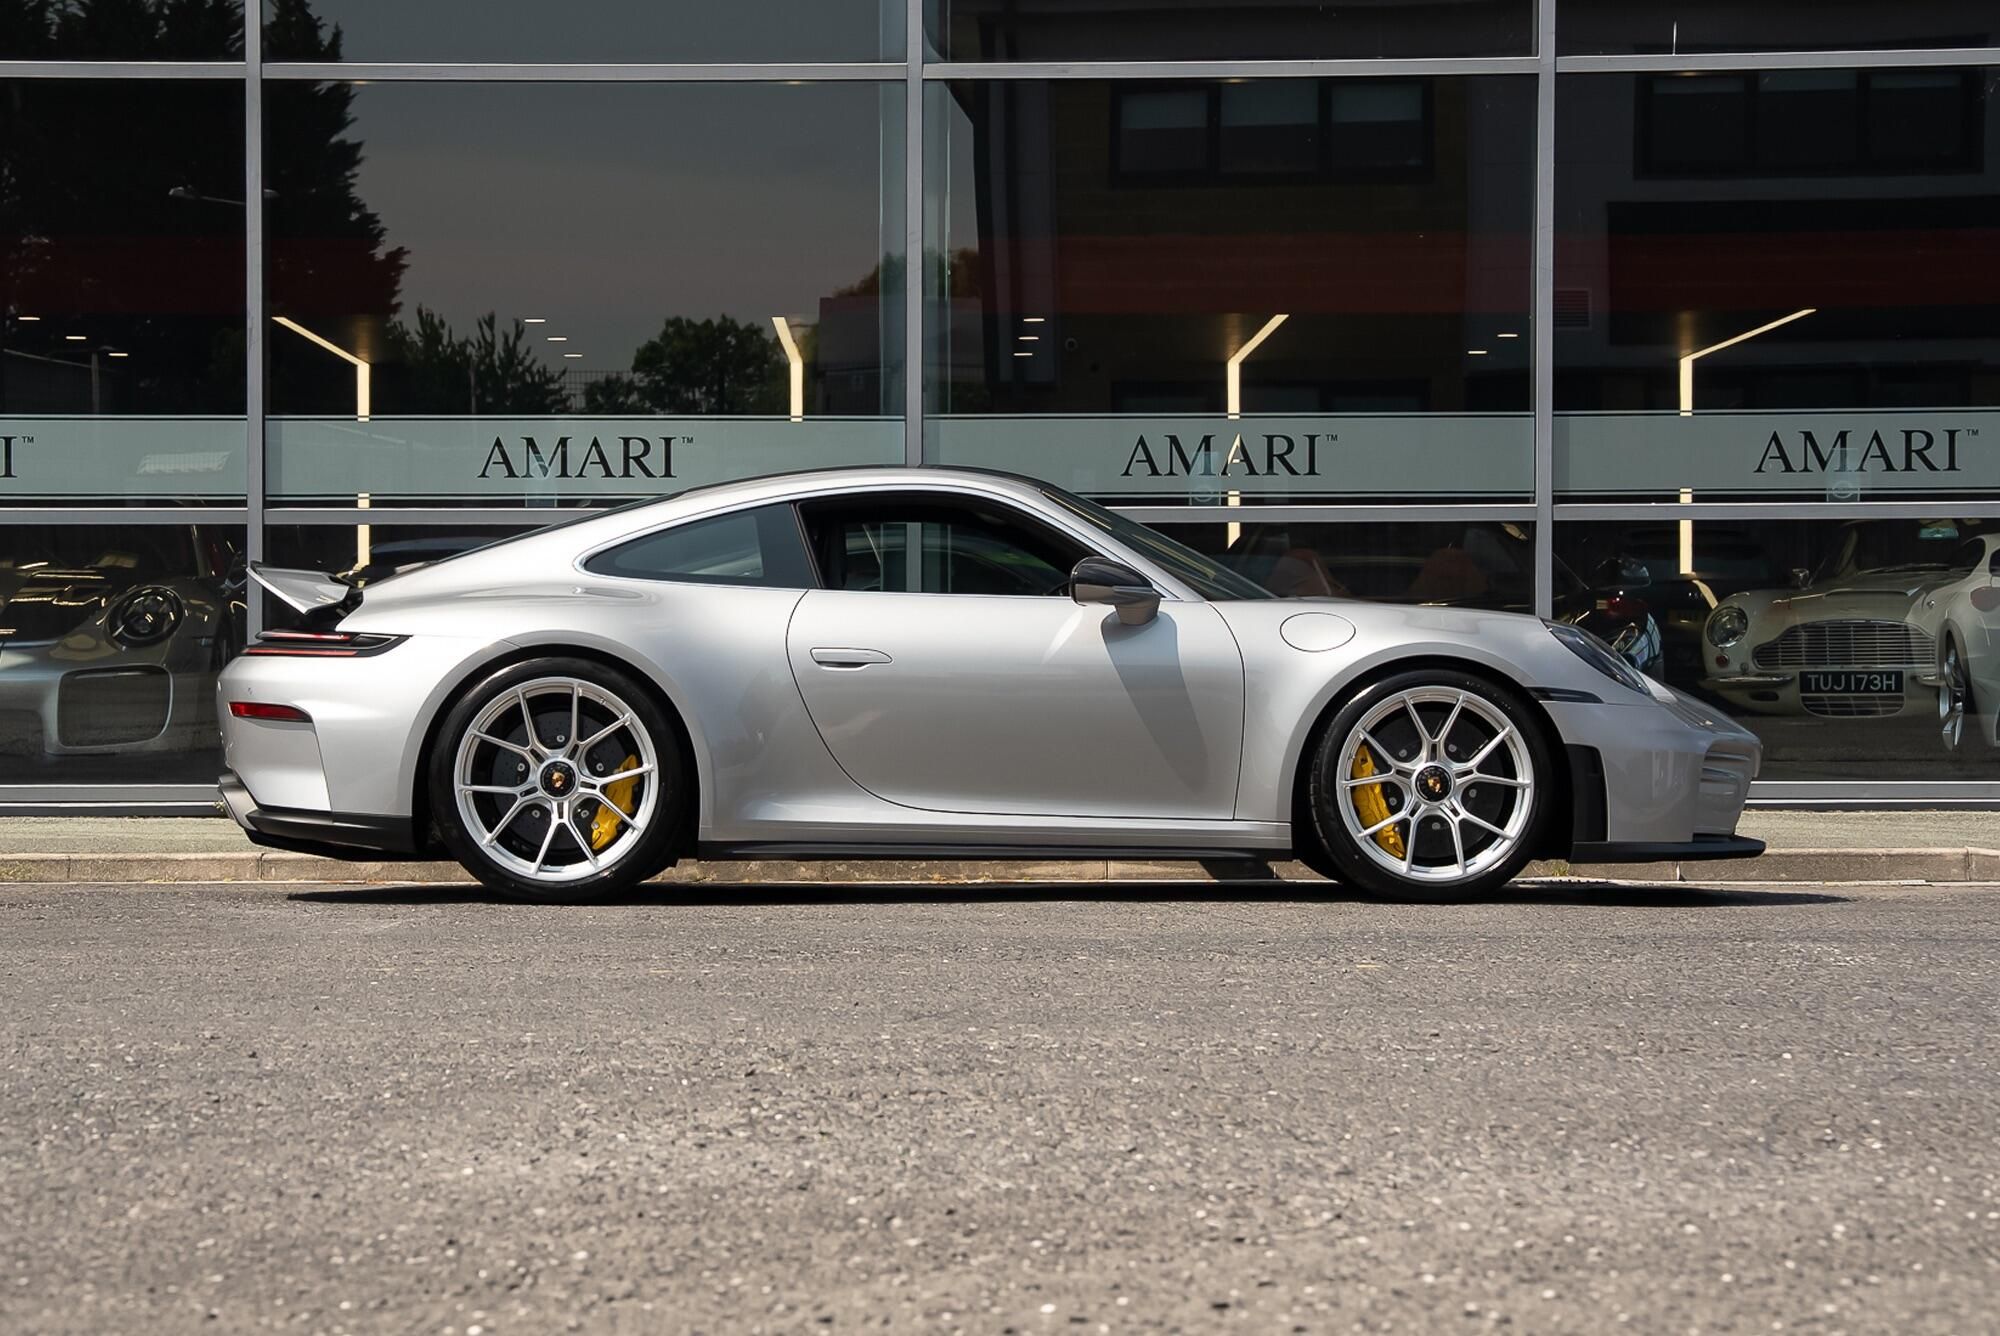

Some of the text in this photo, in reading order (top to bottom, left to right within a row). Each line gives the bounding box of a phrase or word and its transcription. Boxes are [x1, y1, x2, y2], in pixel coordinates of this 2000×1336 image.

[477, 436, 677, 478] AMARI
[1121, 434, 1321, 476] AMARI
[1753, 429, 1961, 473] AMARI
